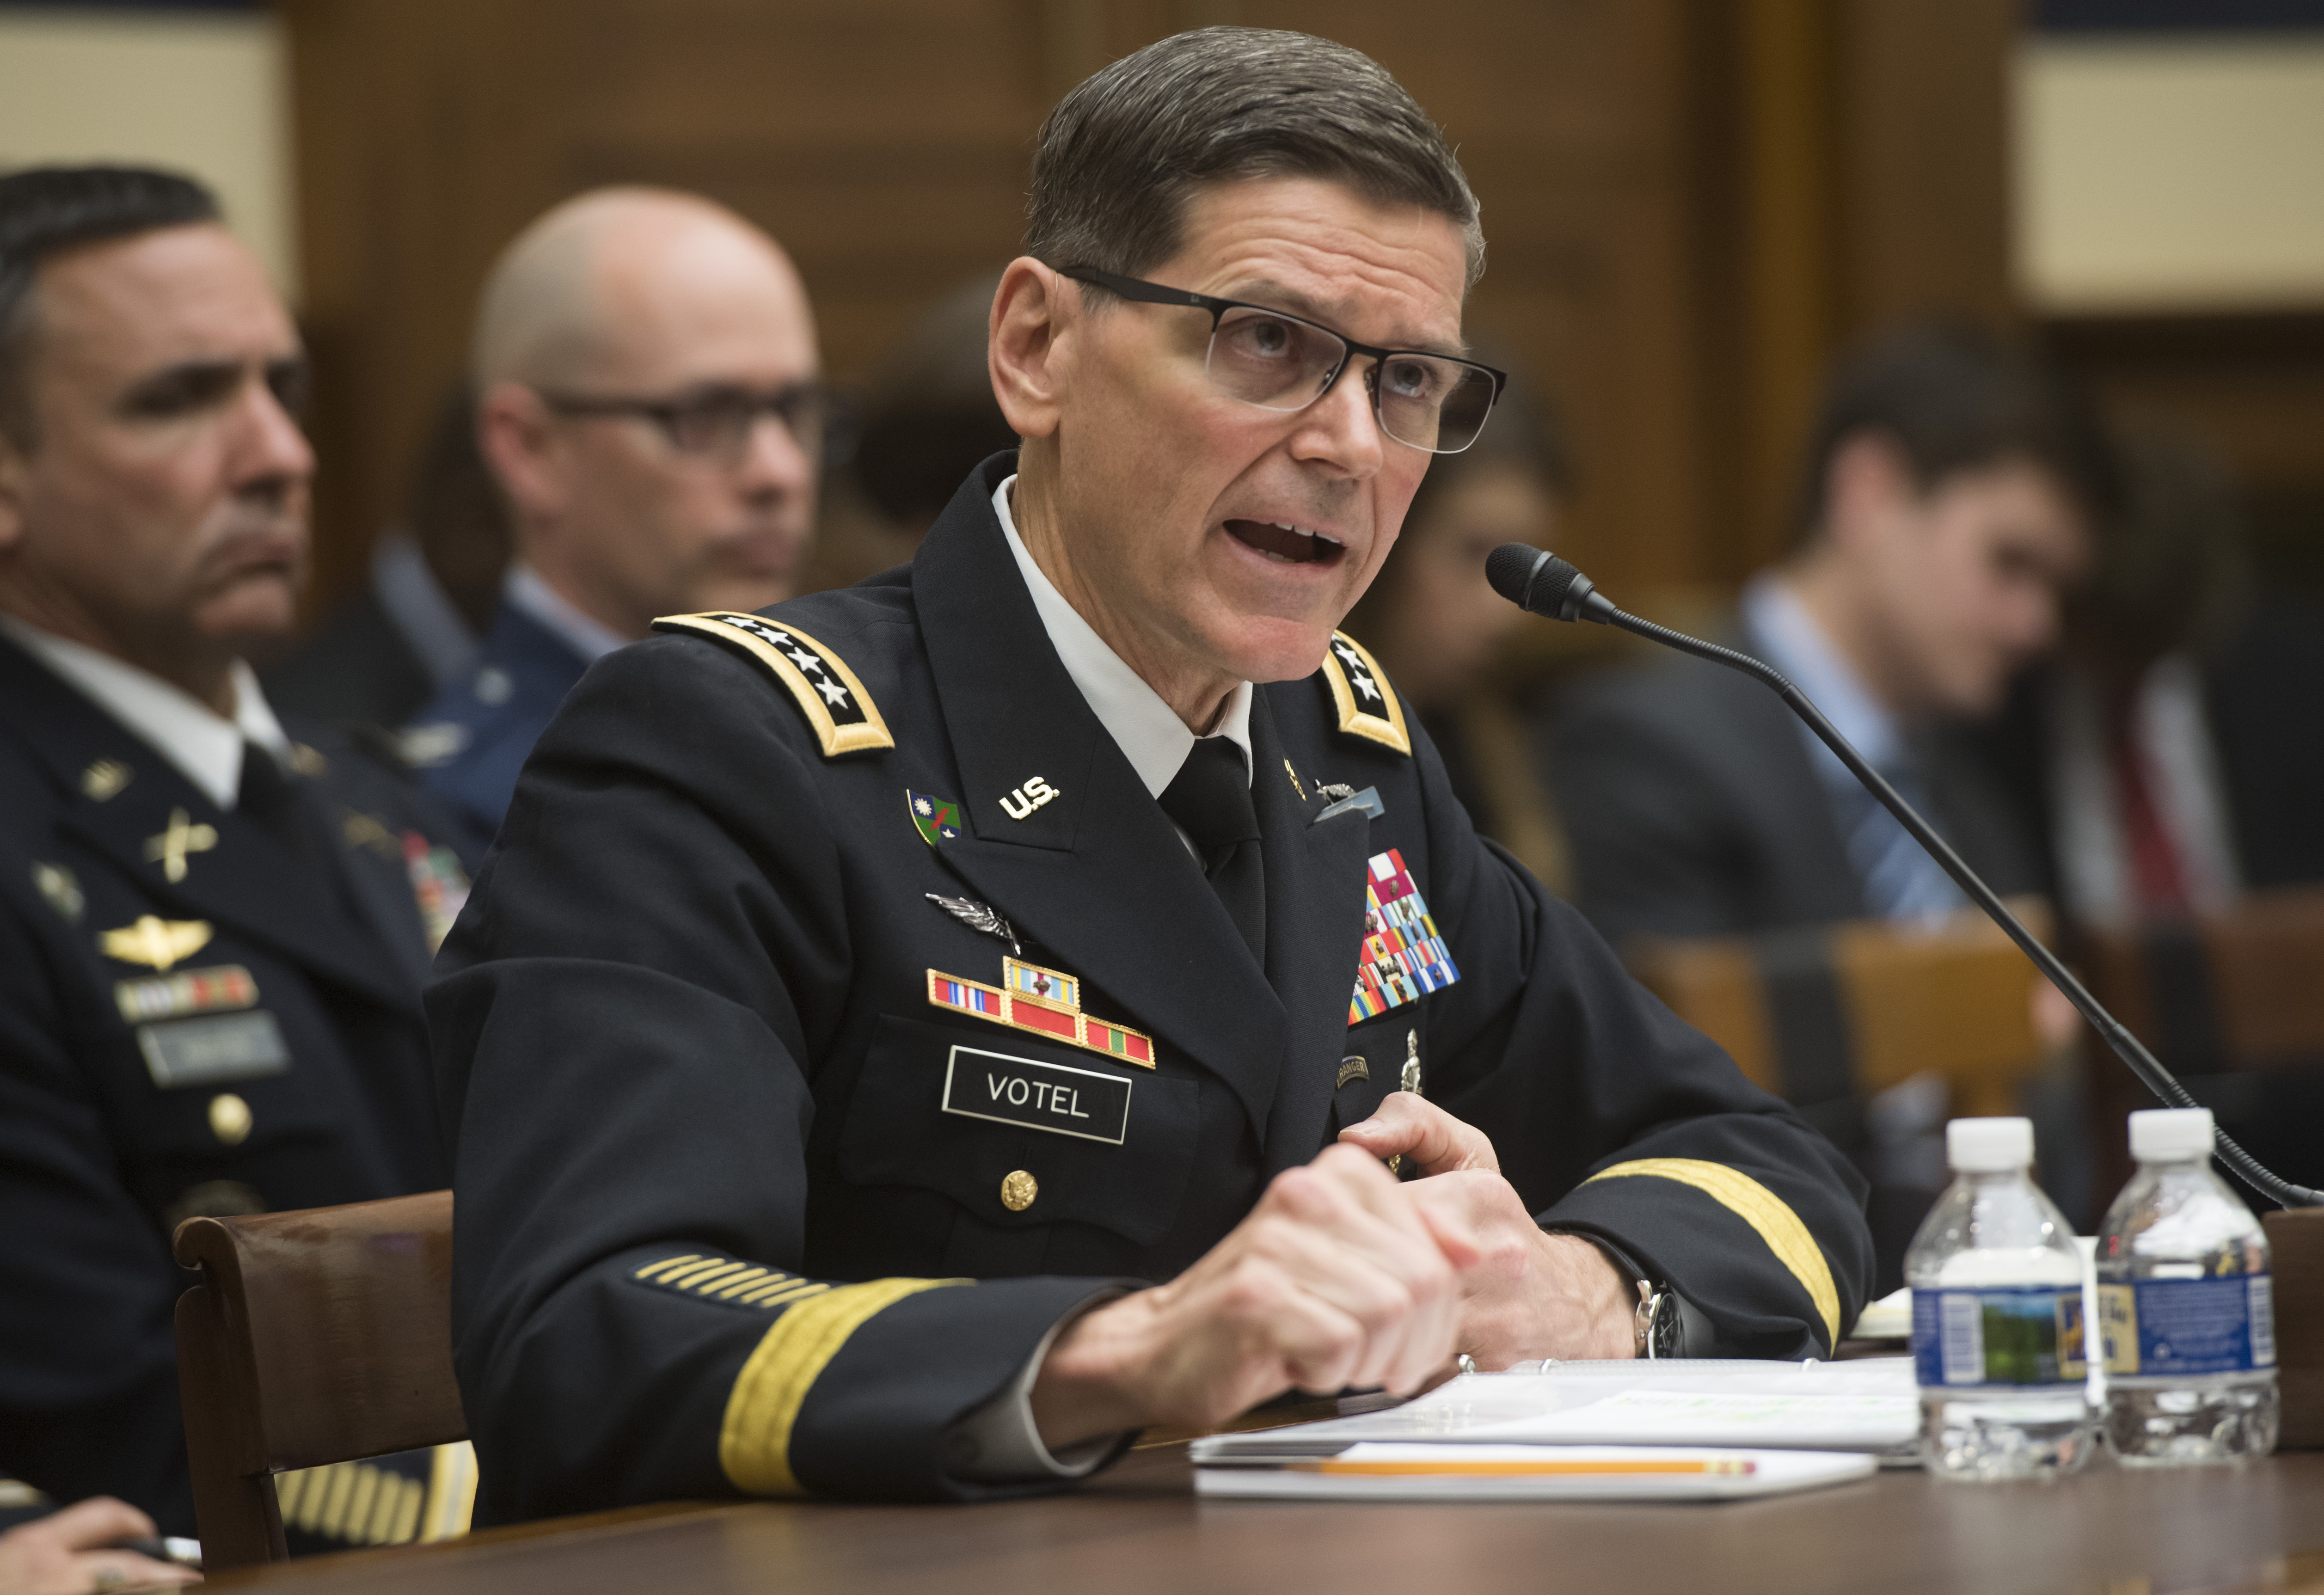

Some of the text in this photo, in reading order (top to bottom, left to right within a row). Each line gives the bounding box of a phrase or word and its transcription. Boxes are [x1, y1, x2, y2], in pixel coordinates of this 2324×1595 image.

[999, 776, 1060, 820] U.S.
[1339, 1061, 1365, 1079] RANGER
[988, 1073, 1089, 1118] VOTEL
